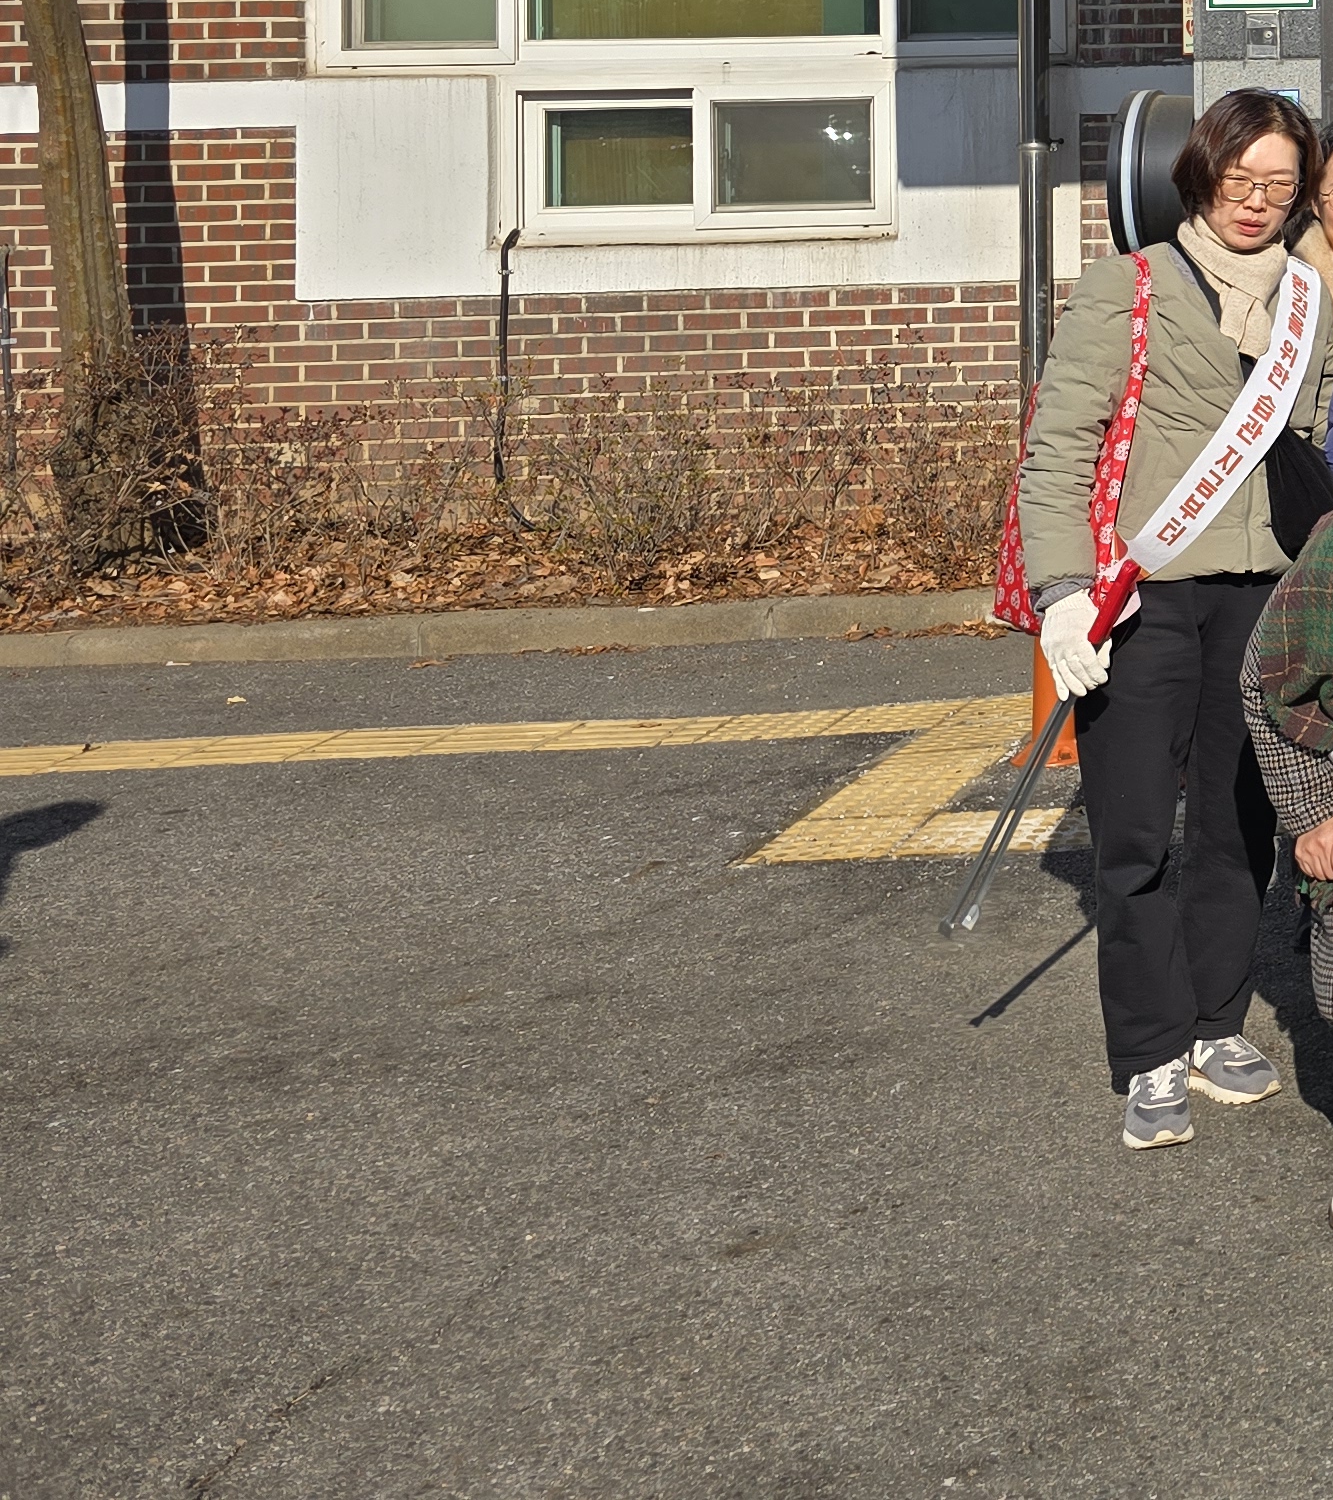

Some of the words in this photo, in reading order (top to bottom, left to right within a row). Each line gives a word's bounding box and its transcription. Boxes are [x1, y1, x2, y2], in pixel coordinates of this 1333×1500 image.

[1268, 341, 1296, 392] 위한
[1236, 393, 1278, 447] 습관
[1156, 443, 1244, 547] 지금부터
